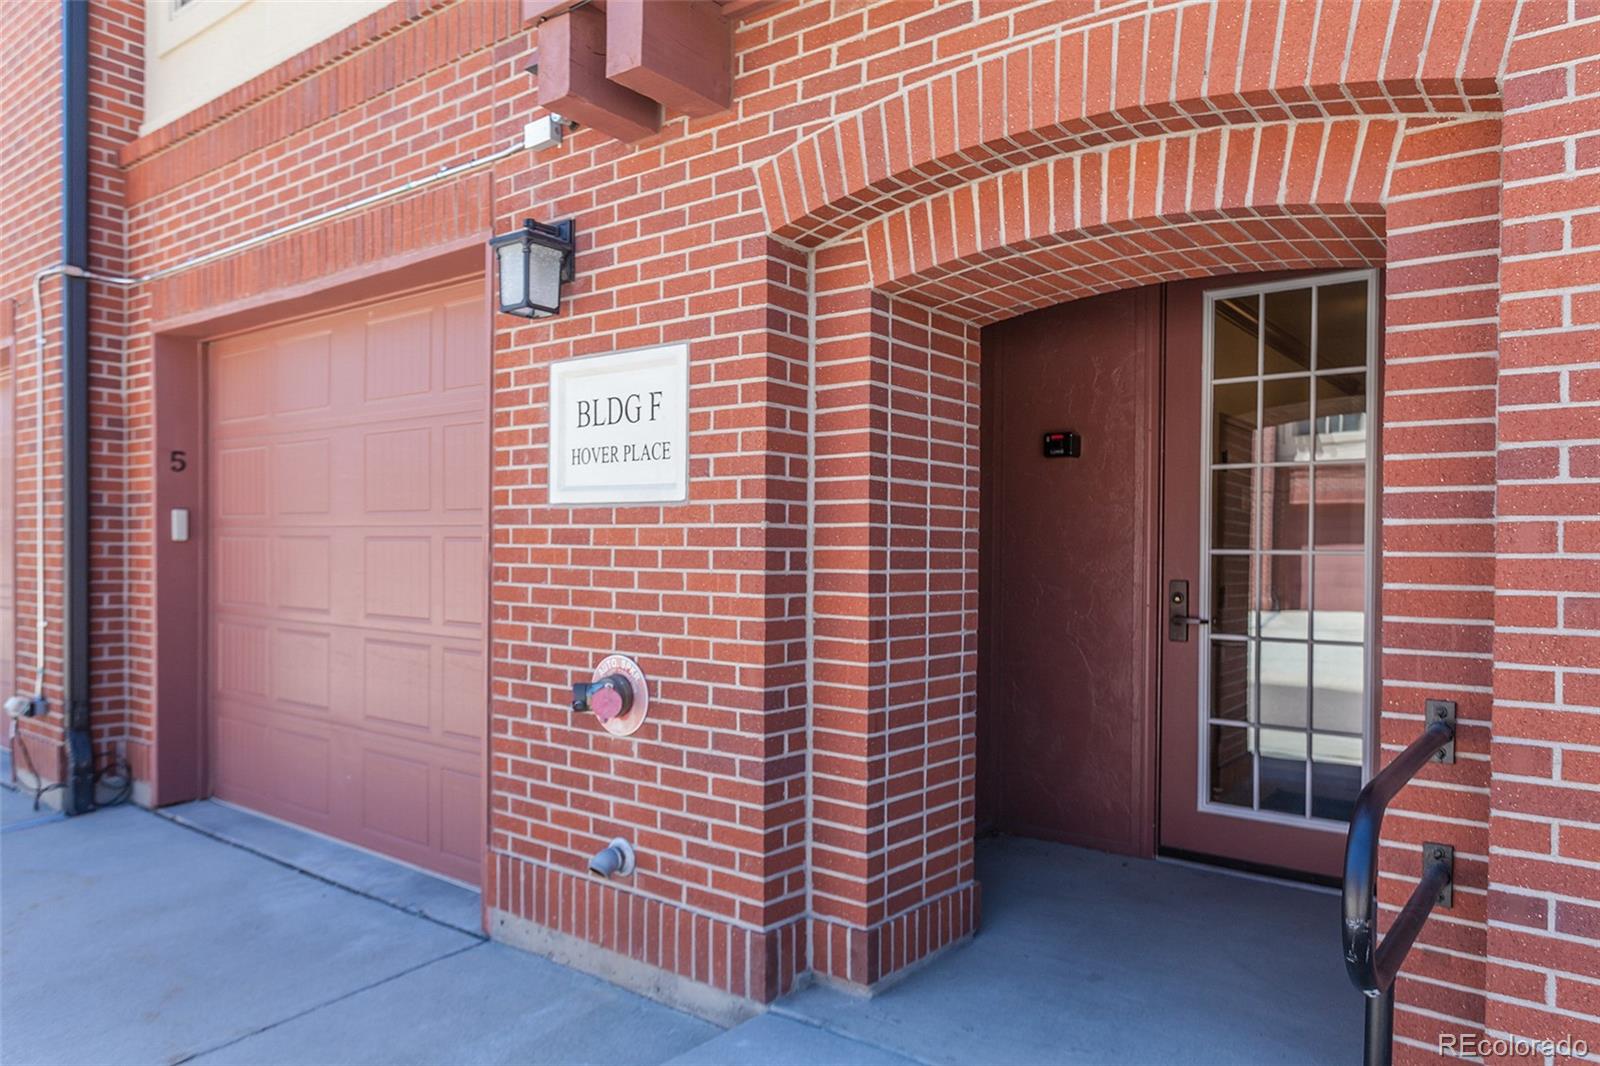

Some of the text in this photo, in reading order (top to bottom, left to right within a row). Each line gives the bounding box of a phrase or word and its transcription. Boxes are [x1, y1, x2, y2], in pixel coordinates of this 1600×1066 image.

[577, 391, 663, 428] BLDG F
[170, 450, 187, 473] 5
[571, 441, 671, 466] HOVER PLACE
